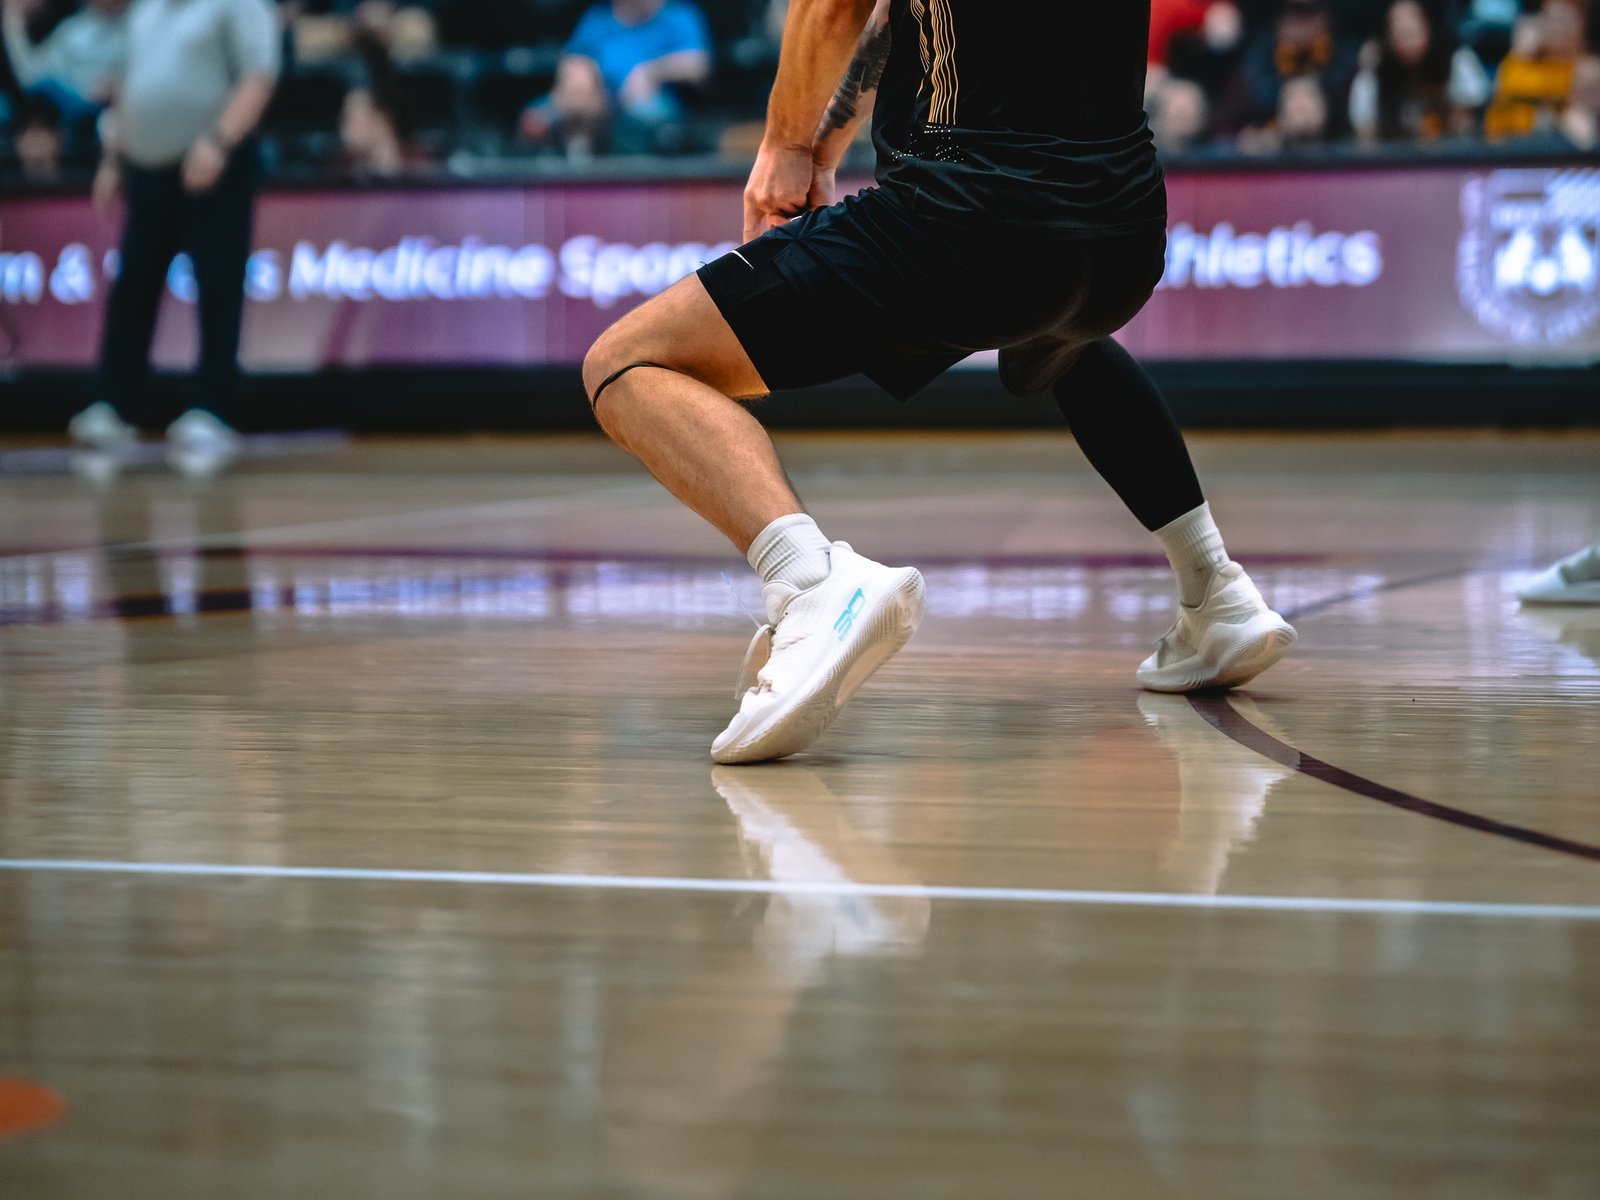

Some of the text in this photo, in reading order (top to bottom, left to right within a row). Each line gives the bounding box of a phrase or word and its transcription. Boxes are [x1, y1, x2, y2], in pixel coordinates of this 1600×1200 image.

[50, 243, 96, 304] &
[289, 235, 553, 302] Medicine
[1157, 222, 1381, 289] hletics
